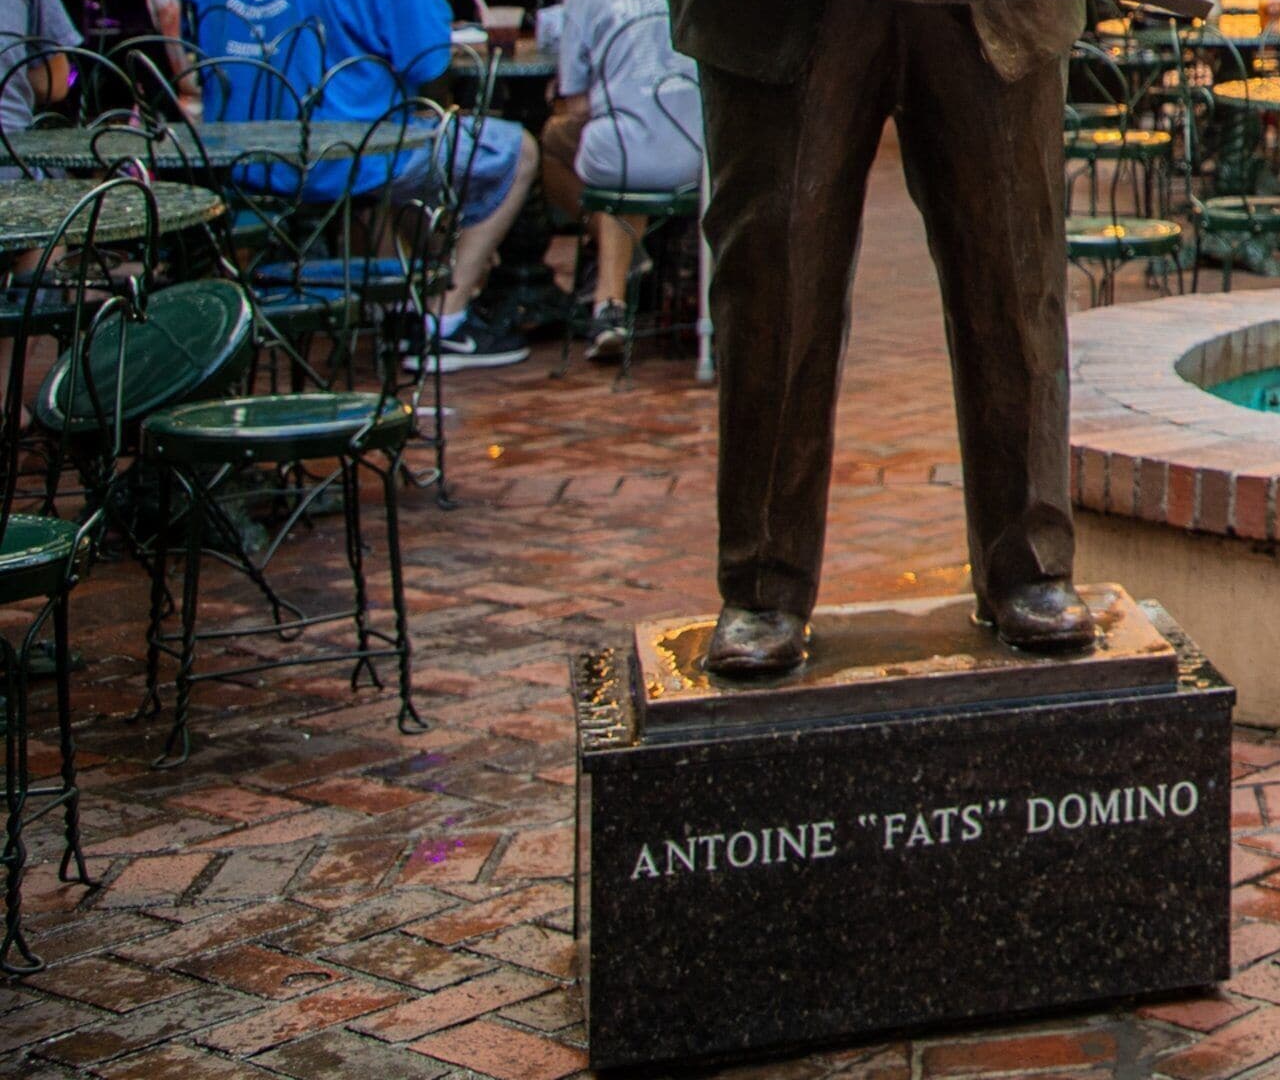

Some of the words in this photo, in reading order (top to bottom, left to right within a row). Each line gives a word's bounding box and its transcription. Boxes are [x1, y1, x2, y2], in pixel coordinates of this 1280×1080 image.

[630, 821, 837, 880] ANTOINE
[858, 798, 1007, 850] "FATS"
[1027, 781, 1199, 834] DOMINO
